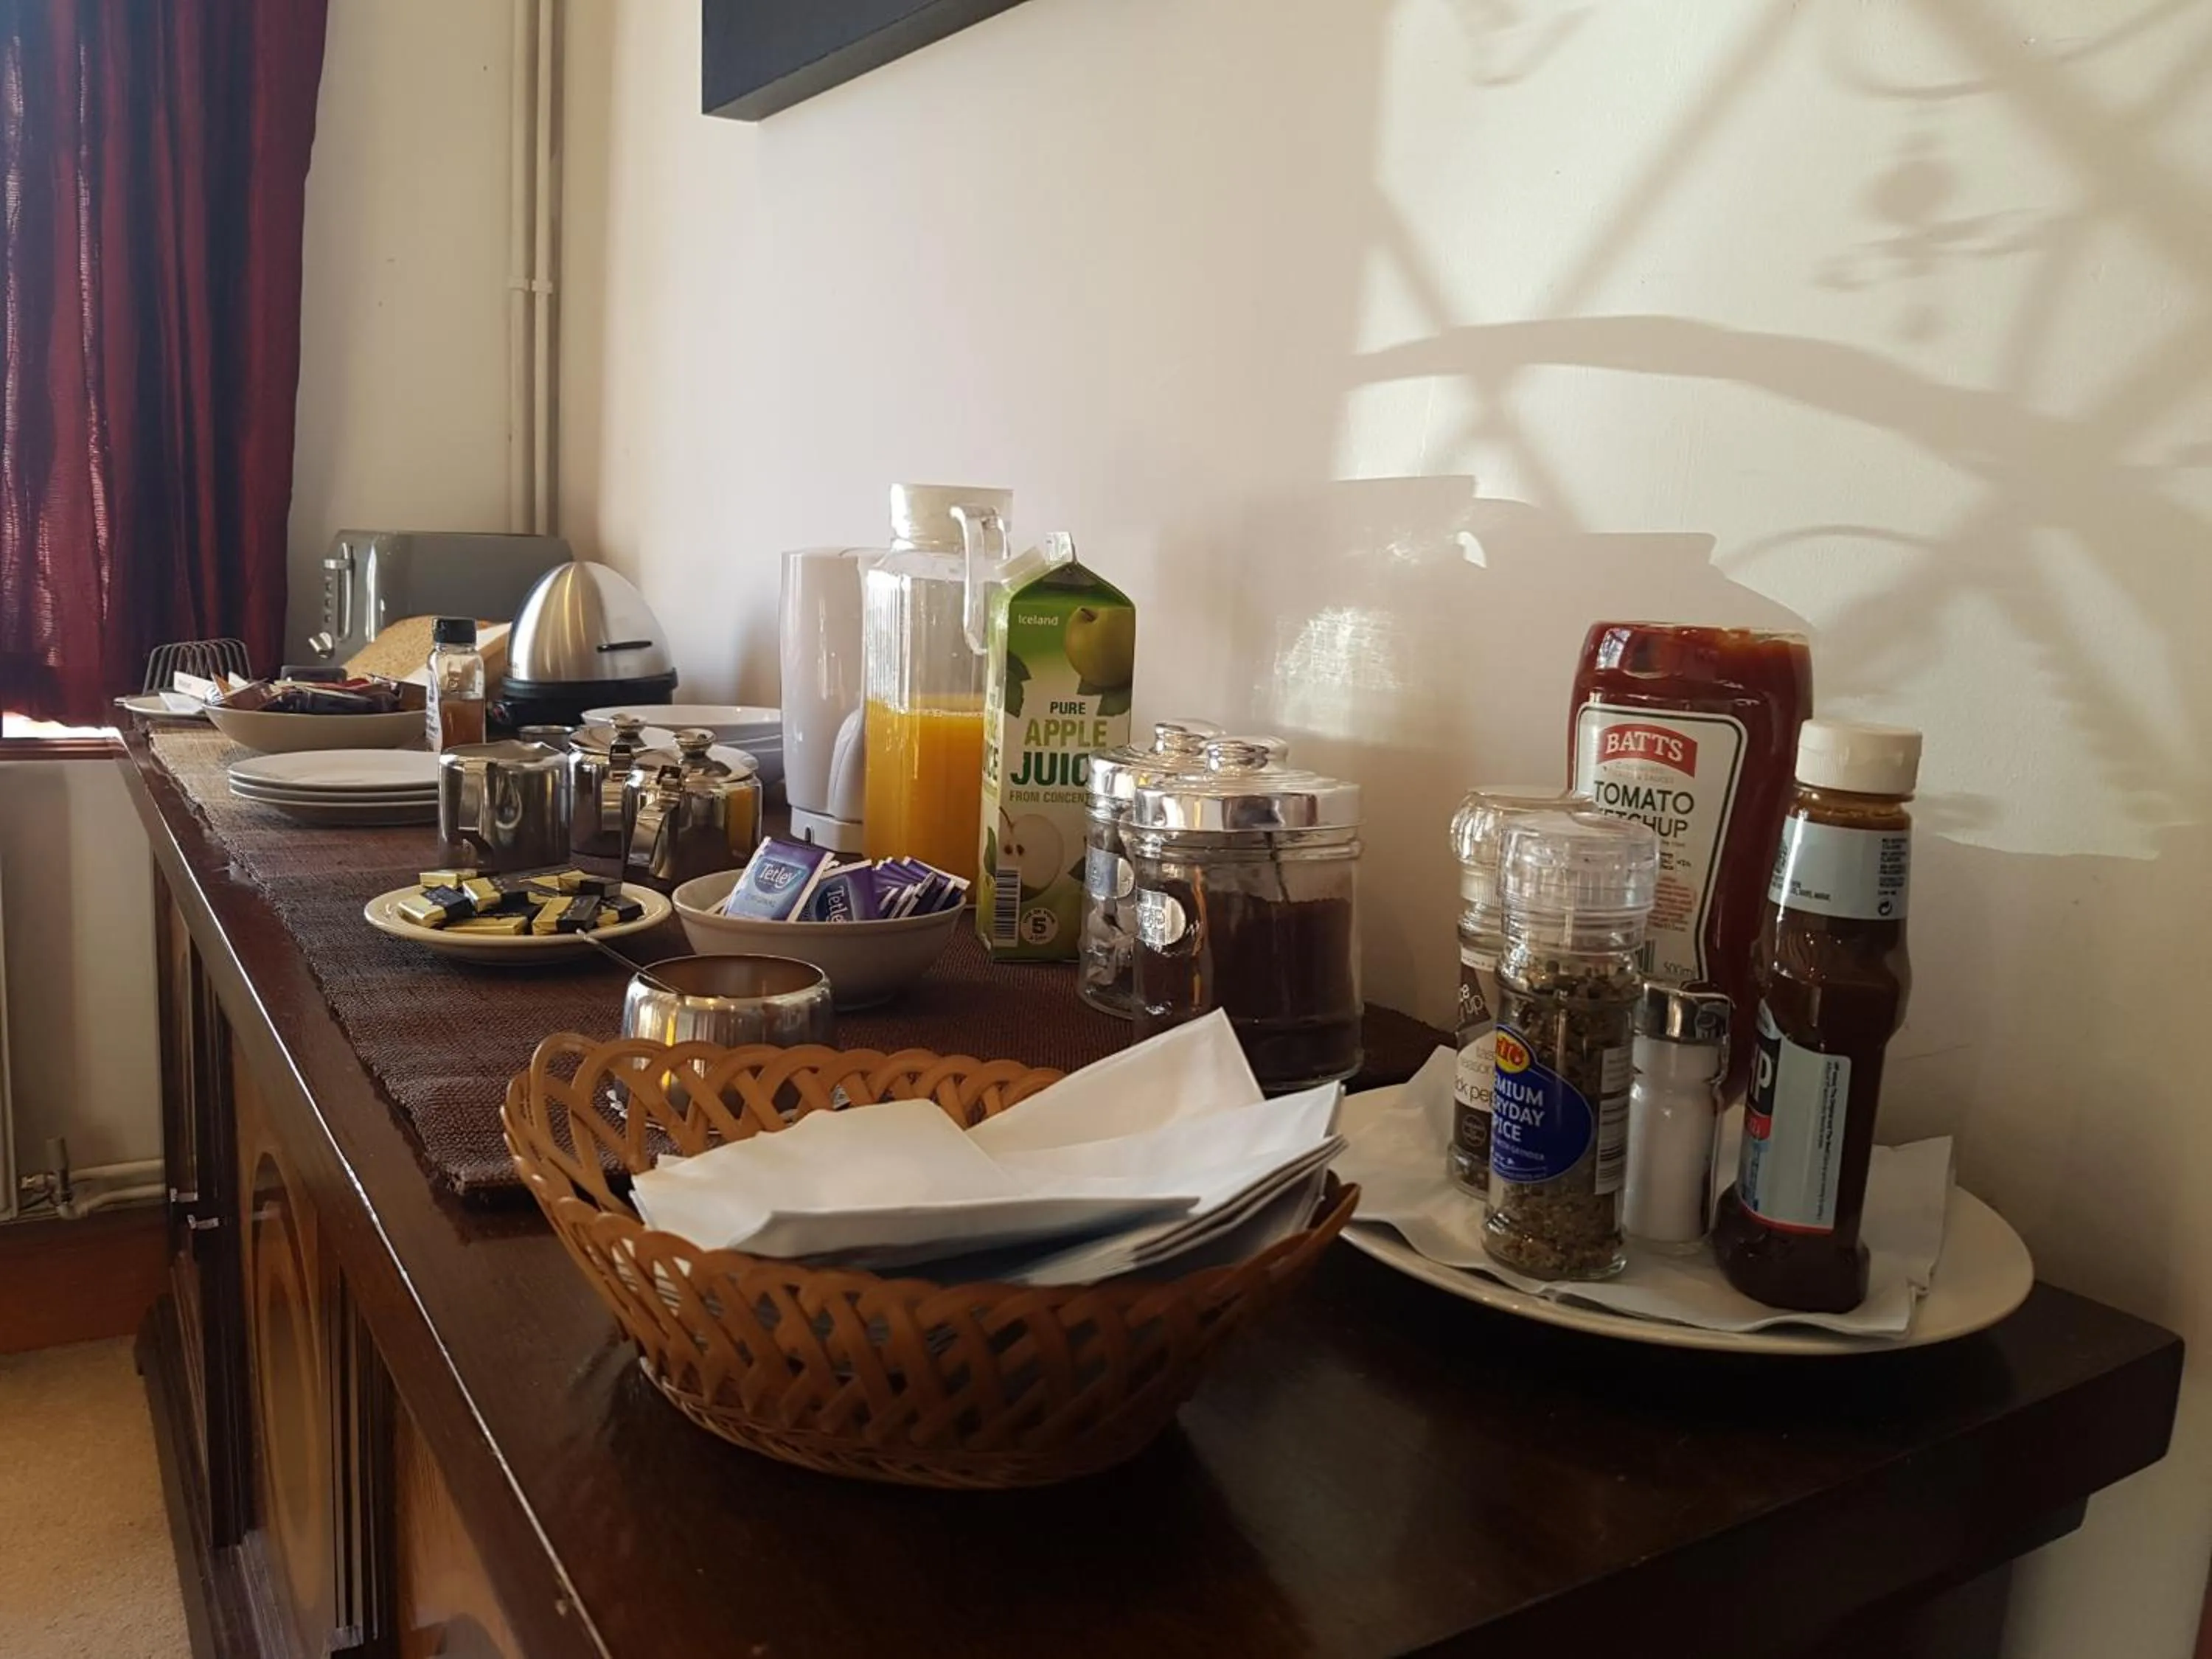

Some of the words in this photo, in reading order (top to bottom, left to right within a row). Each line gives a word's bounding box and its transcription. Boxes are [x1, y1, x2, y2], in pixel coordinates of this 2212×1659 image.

[1018, 613, 1059, 626] Iceland
[1050, 701, 1086, 714] PURE
[1024, 718, 1107, 748] APPLE
[1605, 731, 1683, 762] BATTS
[1010, 751, 1090, 787] JUIC
[1009, 790, 1040, 803] FROM
[1043, 791, 1090, 804] CONCEN
[1594, 780, 1694, 815] TOMATO
[759, 863, 798, 888] Tetley
[827, 885, 847, 922] Tetle
[1032, 917, 1046, 933] 5
[1491, 1110, 1522, 1142] PICE
